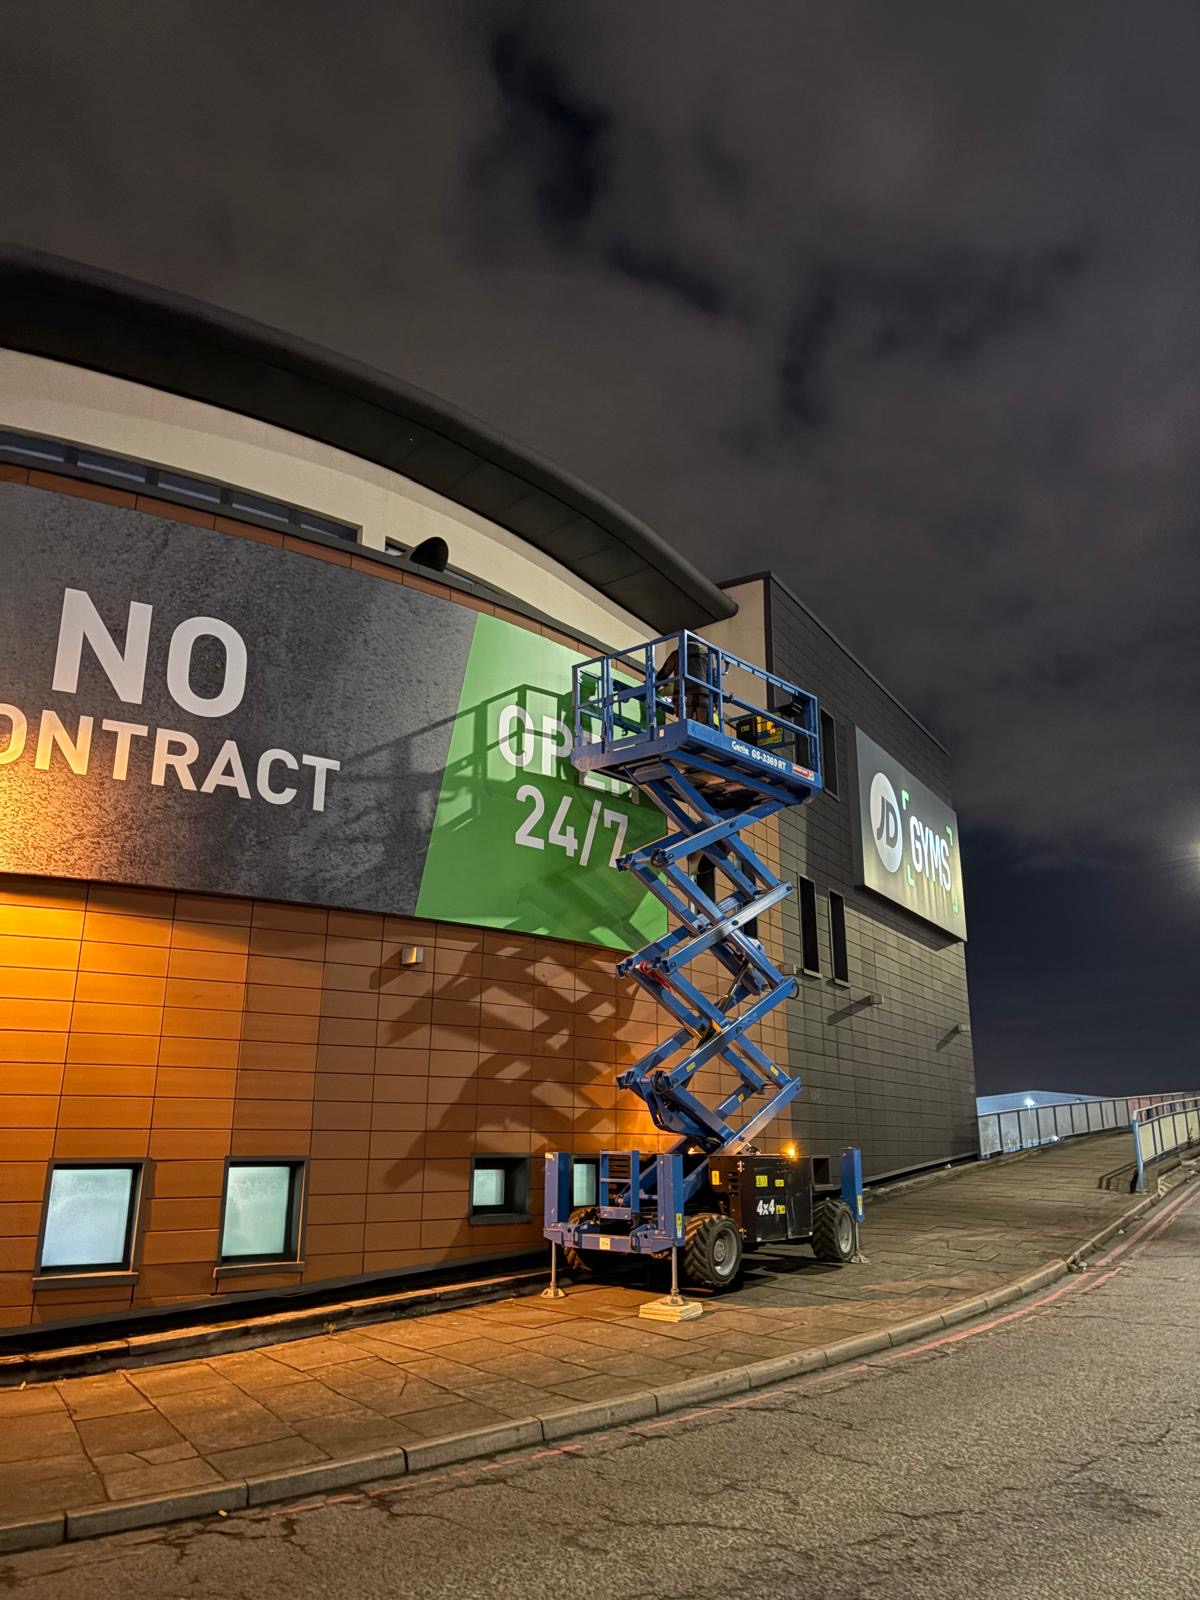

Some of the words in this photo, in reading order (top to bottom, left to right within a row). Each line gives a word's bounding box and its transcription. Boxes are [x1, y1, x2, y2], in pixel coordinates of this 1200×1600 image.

[52, 587, 248, 718] NO
[498, 704, 641, 806] OPE
[752, 749, 777, 766] GS-3369
[778, 760, 786, 770] RT
[515, 784, 628, 869] 24/7
[876, 795, 898, 849] JD
[909, 815, 952, 892] GYMS
[756, 1198, 775, 1216] 4x4
